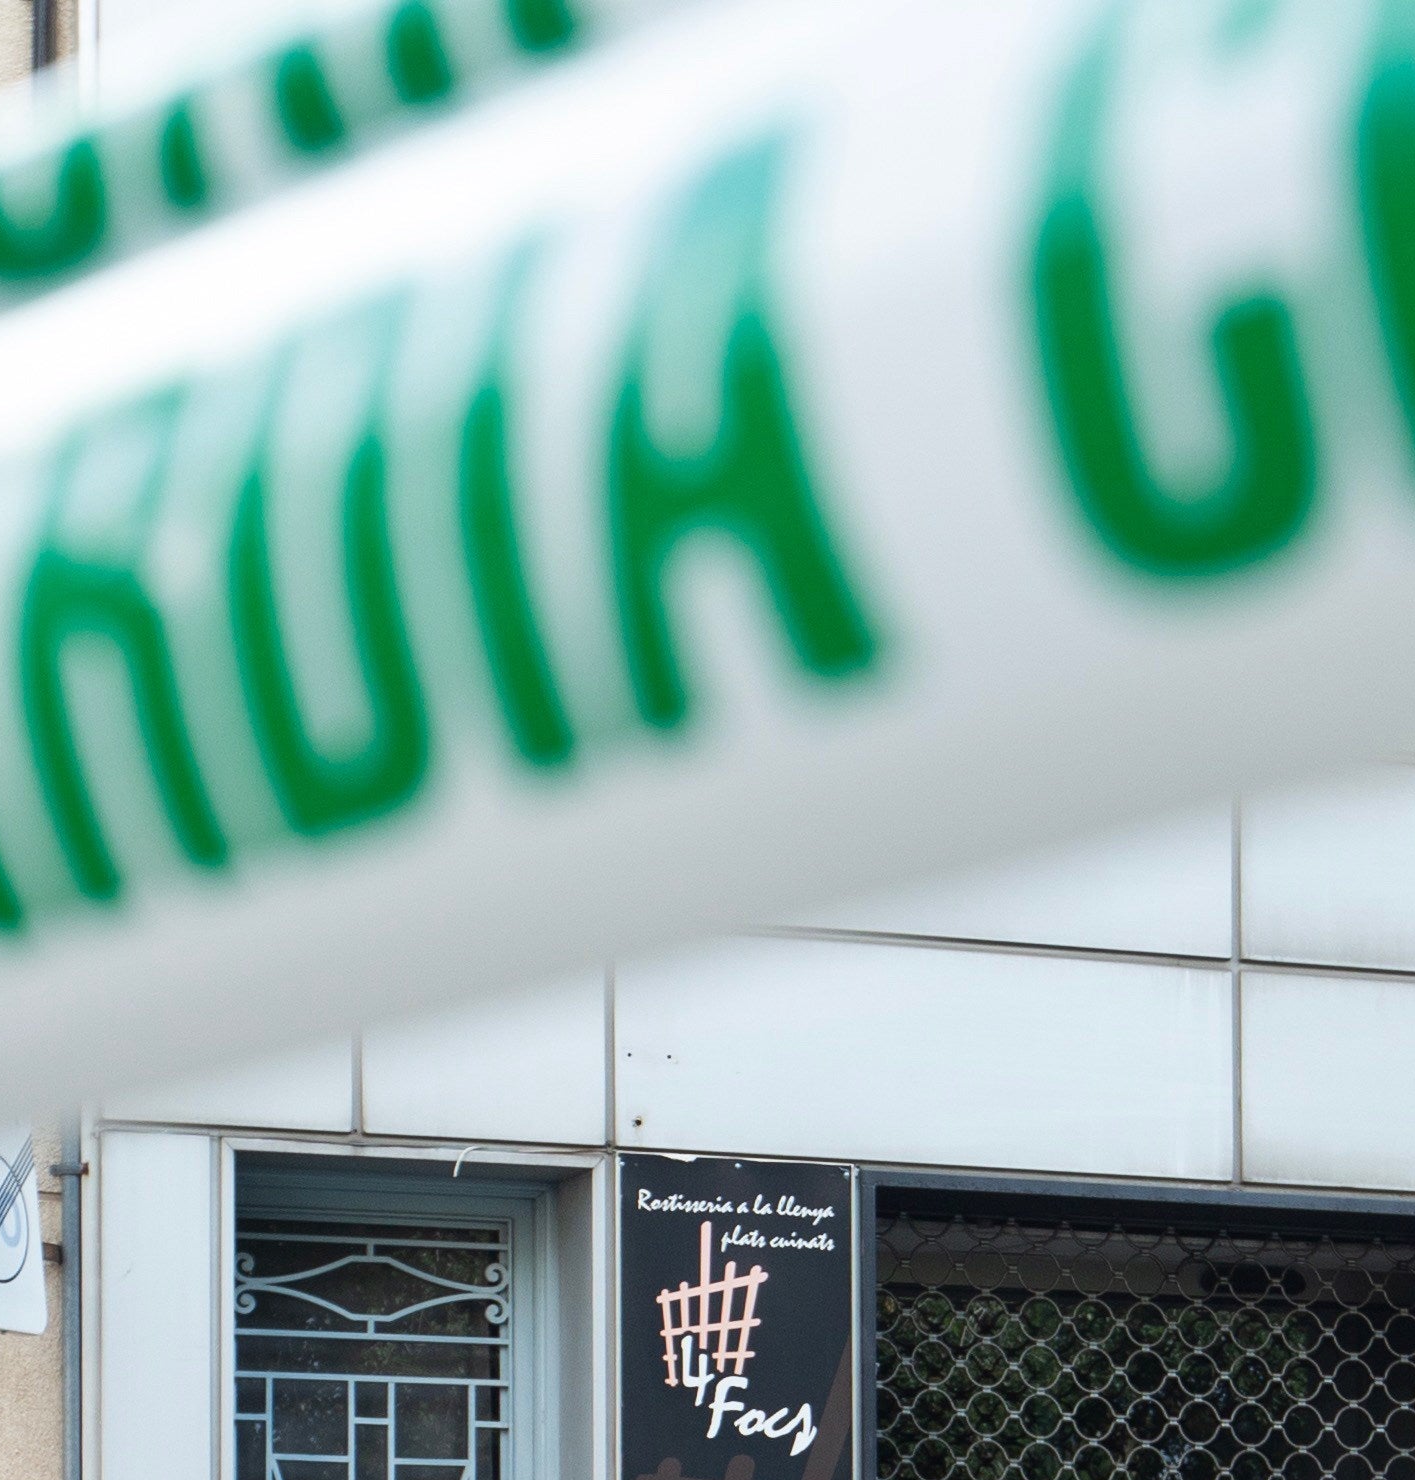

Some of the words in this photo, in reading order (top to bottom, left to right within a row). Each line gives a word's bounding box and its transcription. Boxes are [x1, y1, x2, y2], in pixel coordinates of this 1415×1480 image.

[637, 1188, 733, 1213] Rostisseria
[736, 1201, 749, 1214] a
[752, 1193, 772, 1215] la
[777, 1195, 835, 1226] llenya
[720, 1224, 766, 1252] plats
[769, 1231, 835, 1251] cuinats
[681, 1335, 715, 1406] 4
[706, 1376, 818, 1457] Focs
